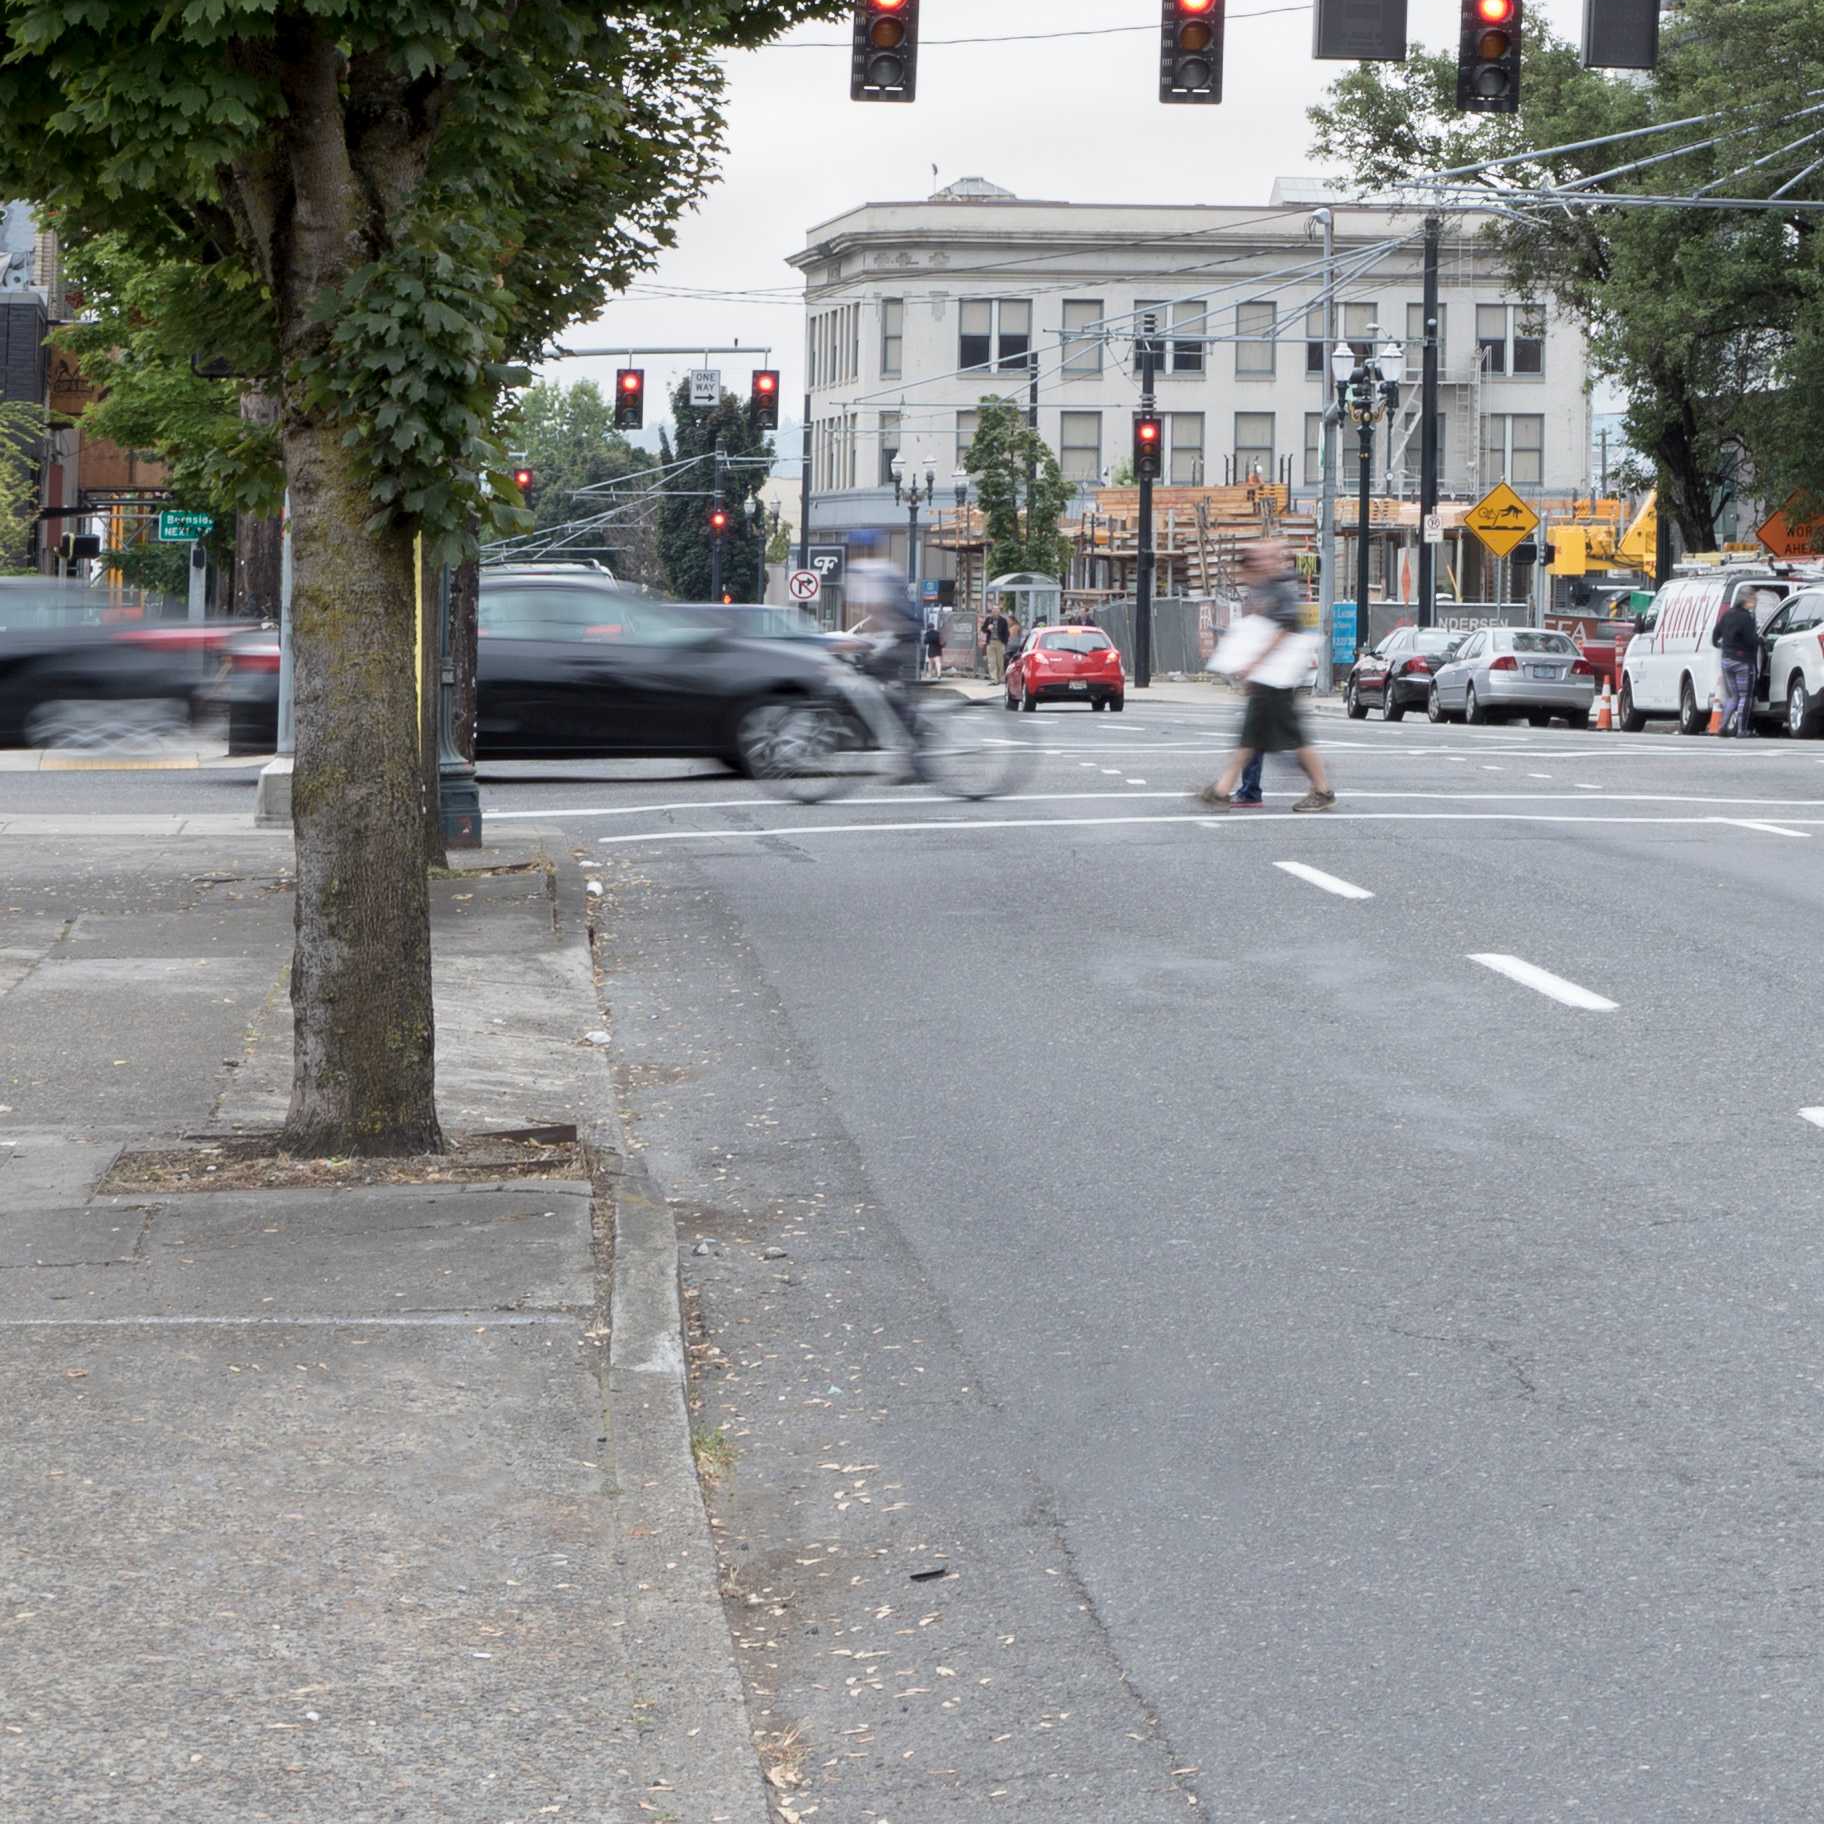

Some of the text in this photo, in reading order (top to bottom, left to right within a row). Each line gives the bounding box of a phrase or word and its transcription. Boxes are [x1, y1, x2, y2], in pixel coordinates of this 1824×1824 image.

[696, 373, 715, 382] ONE
[696, 383, 715, 392] WAY
[1438, 617, 1509, 632] NDERSEN
